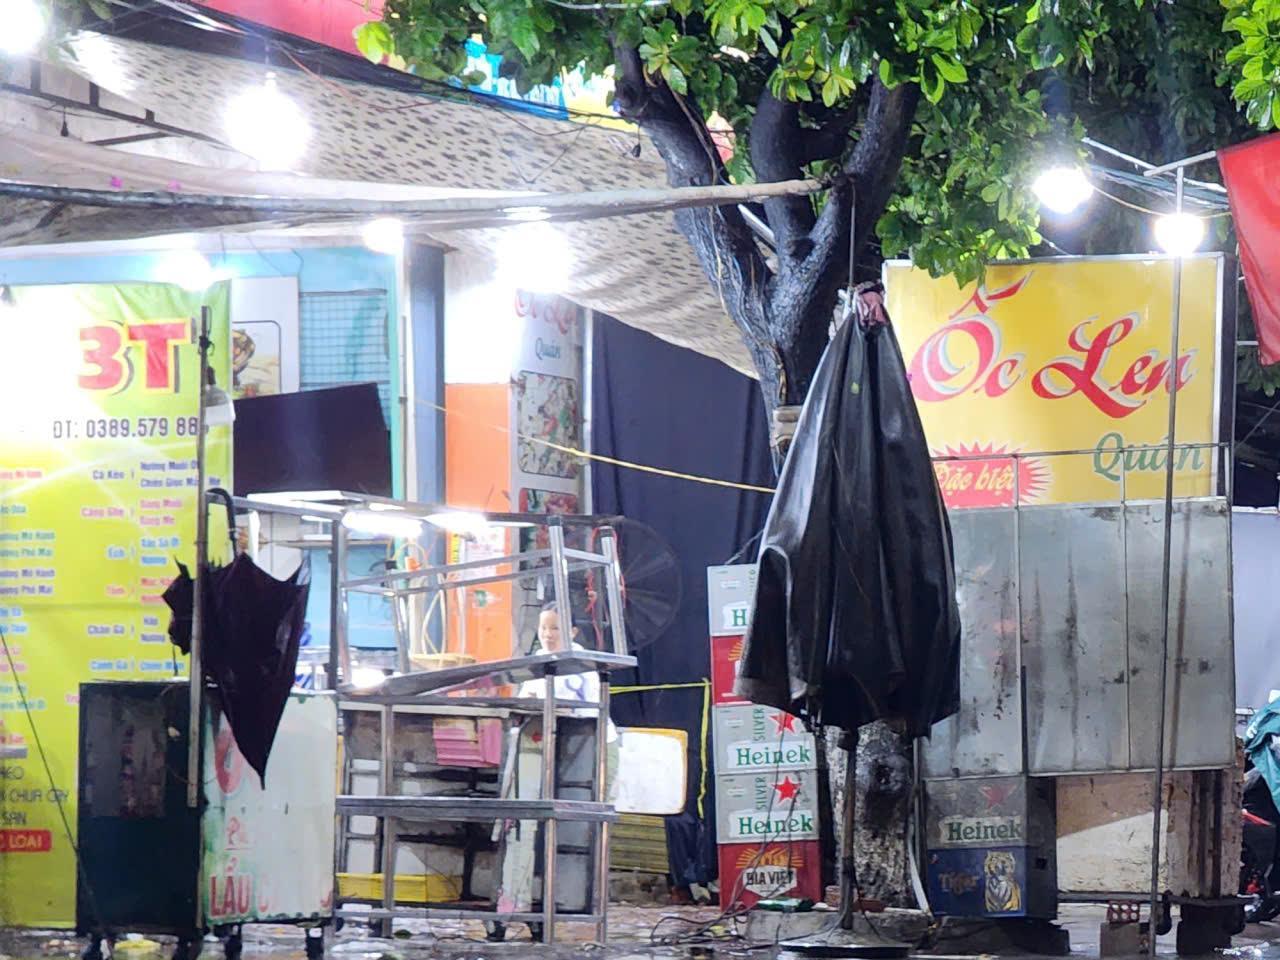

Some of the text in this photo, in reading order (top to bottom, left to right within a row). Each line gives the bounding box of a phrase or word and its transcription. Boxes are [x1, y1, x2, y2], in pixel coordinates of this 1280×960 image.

[79, 322, 192, 392] 3T
[1031, 314, 1196, 419] Len
[87, 418, 168, 438] 0389.579
[1093, 432, 1205, 482] Quán
[752, 708, 765, 742] SILVER
[736, 745, 811, 766] Heinek
[755, 776, 767, 811] SILVER
[738, 814, 814, 835] Heinek
[746, 871, 767, 886] BIA
